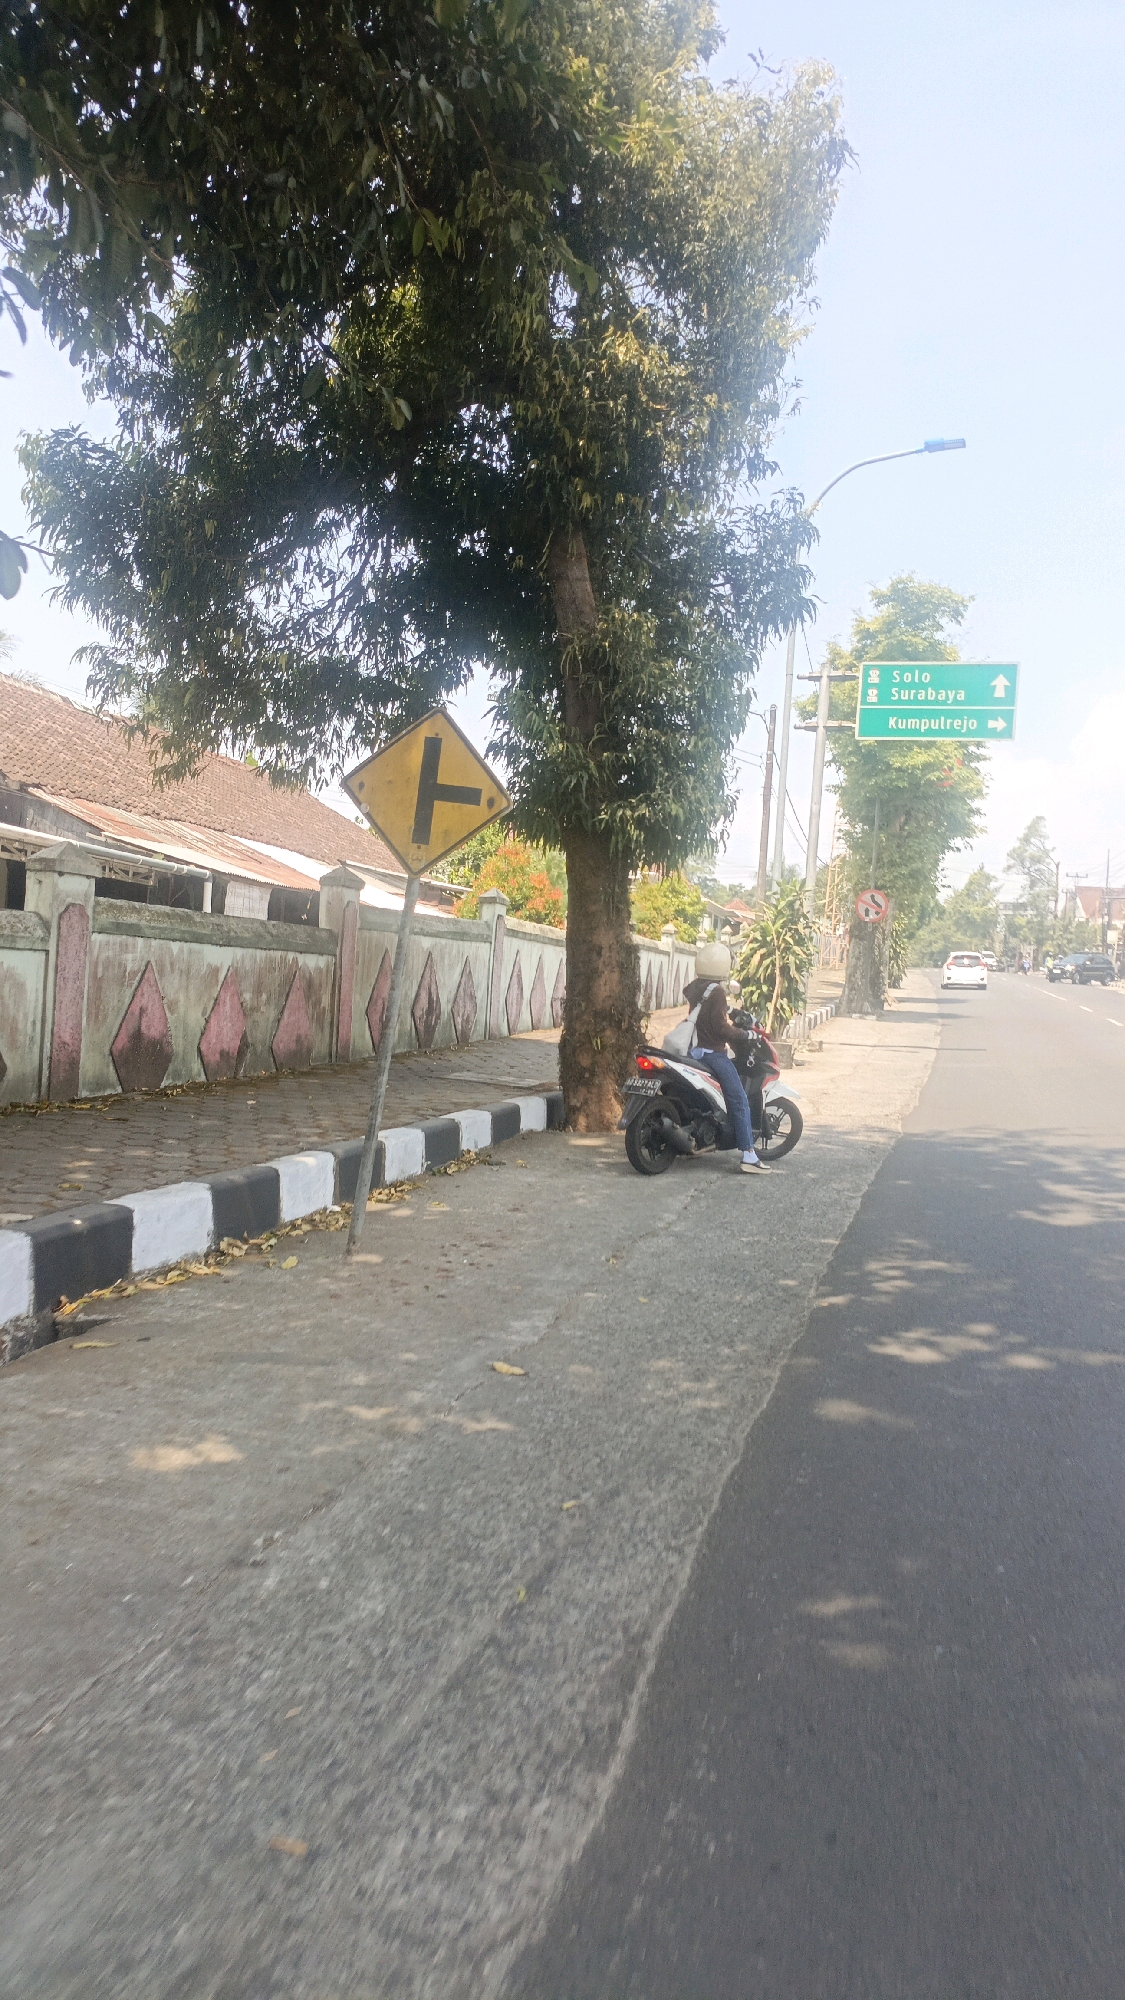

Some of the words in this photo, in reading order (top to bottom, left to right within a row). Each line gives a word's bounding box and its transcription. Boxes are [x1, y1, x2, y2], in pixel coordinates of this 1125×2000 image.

[892, 669, 931, 683] Solo
[890, 687, 965, 704] Surabaya
[888, 716, 978, 733] Kumpulrejo
